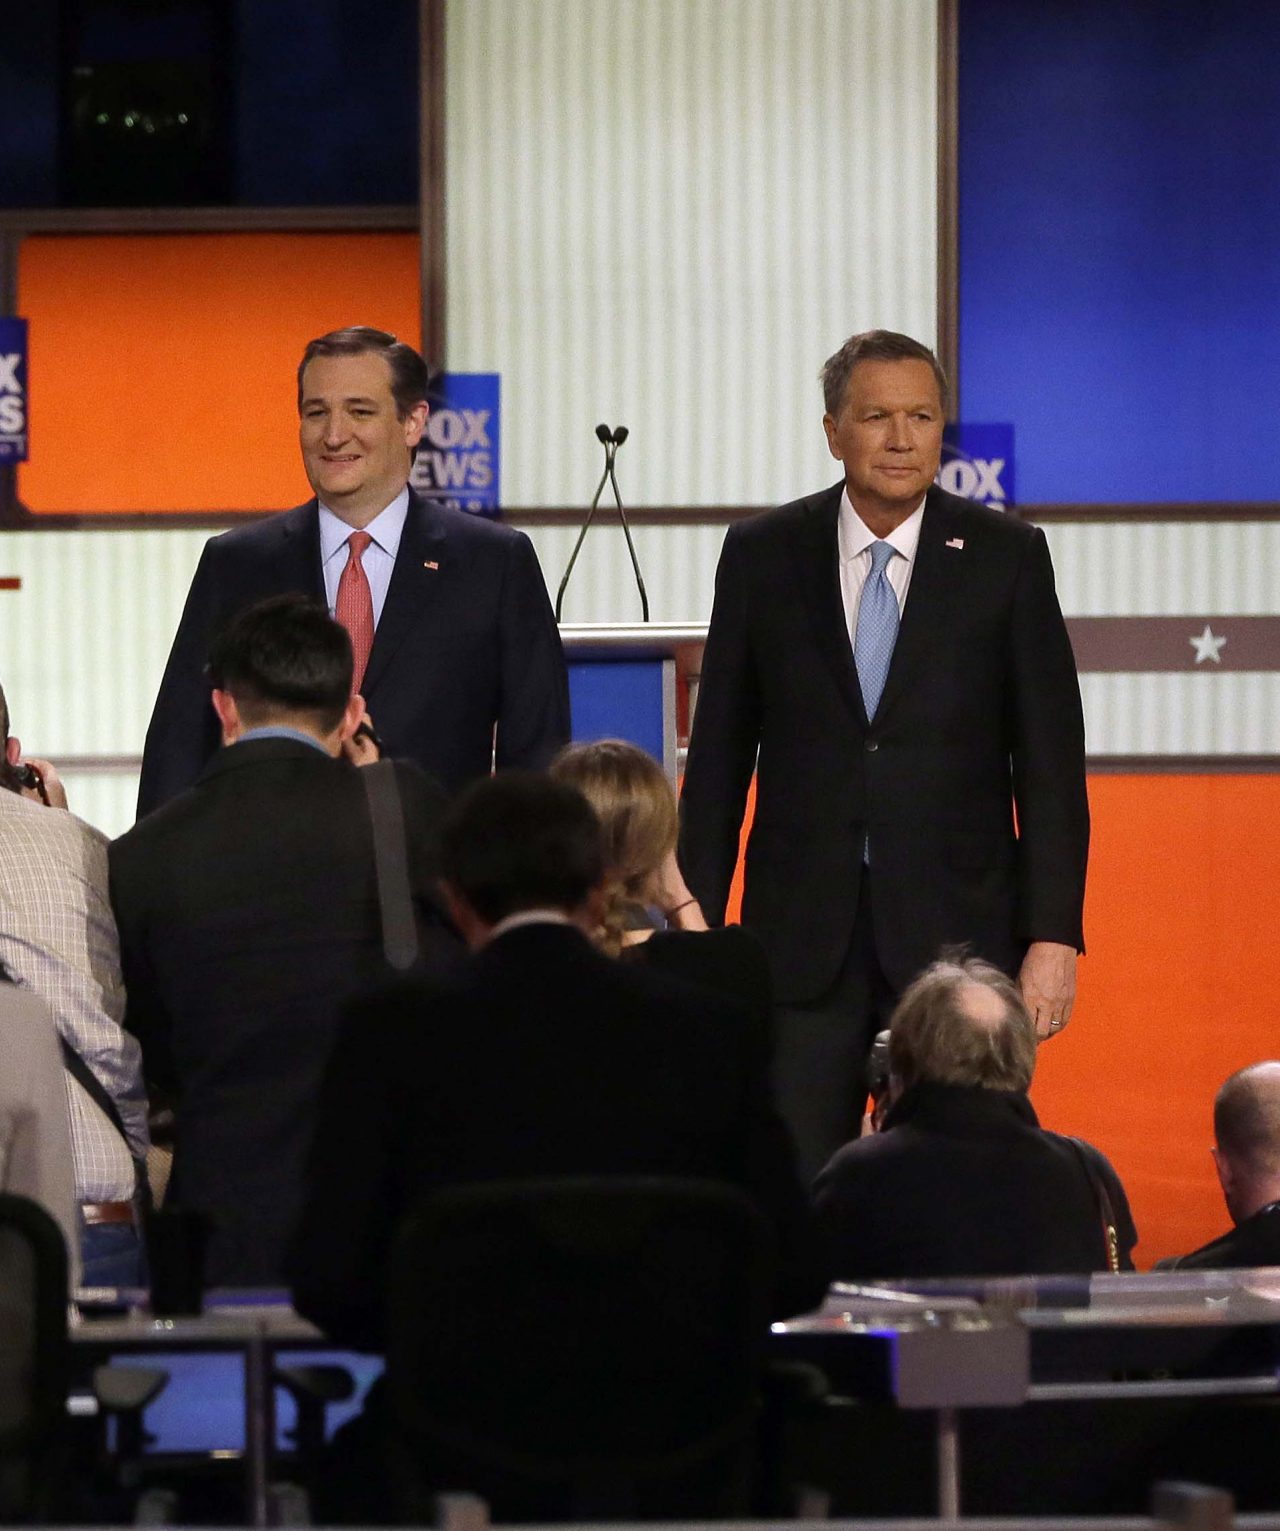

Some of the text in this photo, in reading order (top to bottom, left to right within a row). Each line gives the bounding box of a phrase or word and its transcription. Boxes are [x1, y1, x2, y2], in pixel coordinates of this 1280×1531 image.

[423, 409, 491, 449] OX
[408, 451, 493, 488] EWS
[934, 458, 1006, 500] OX
